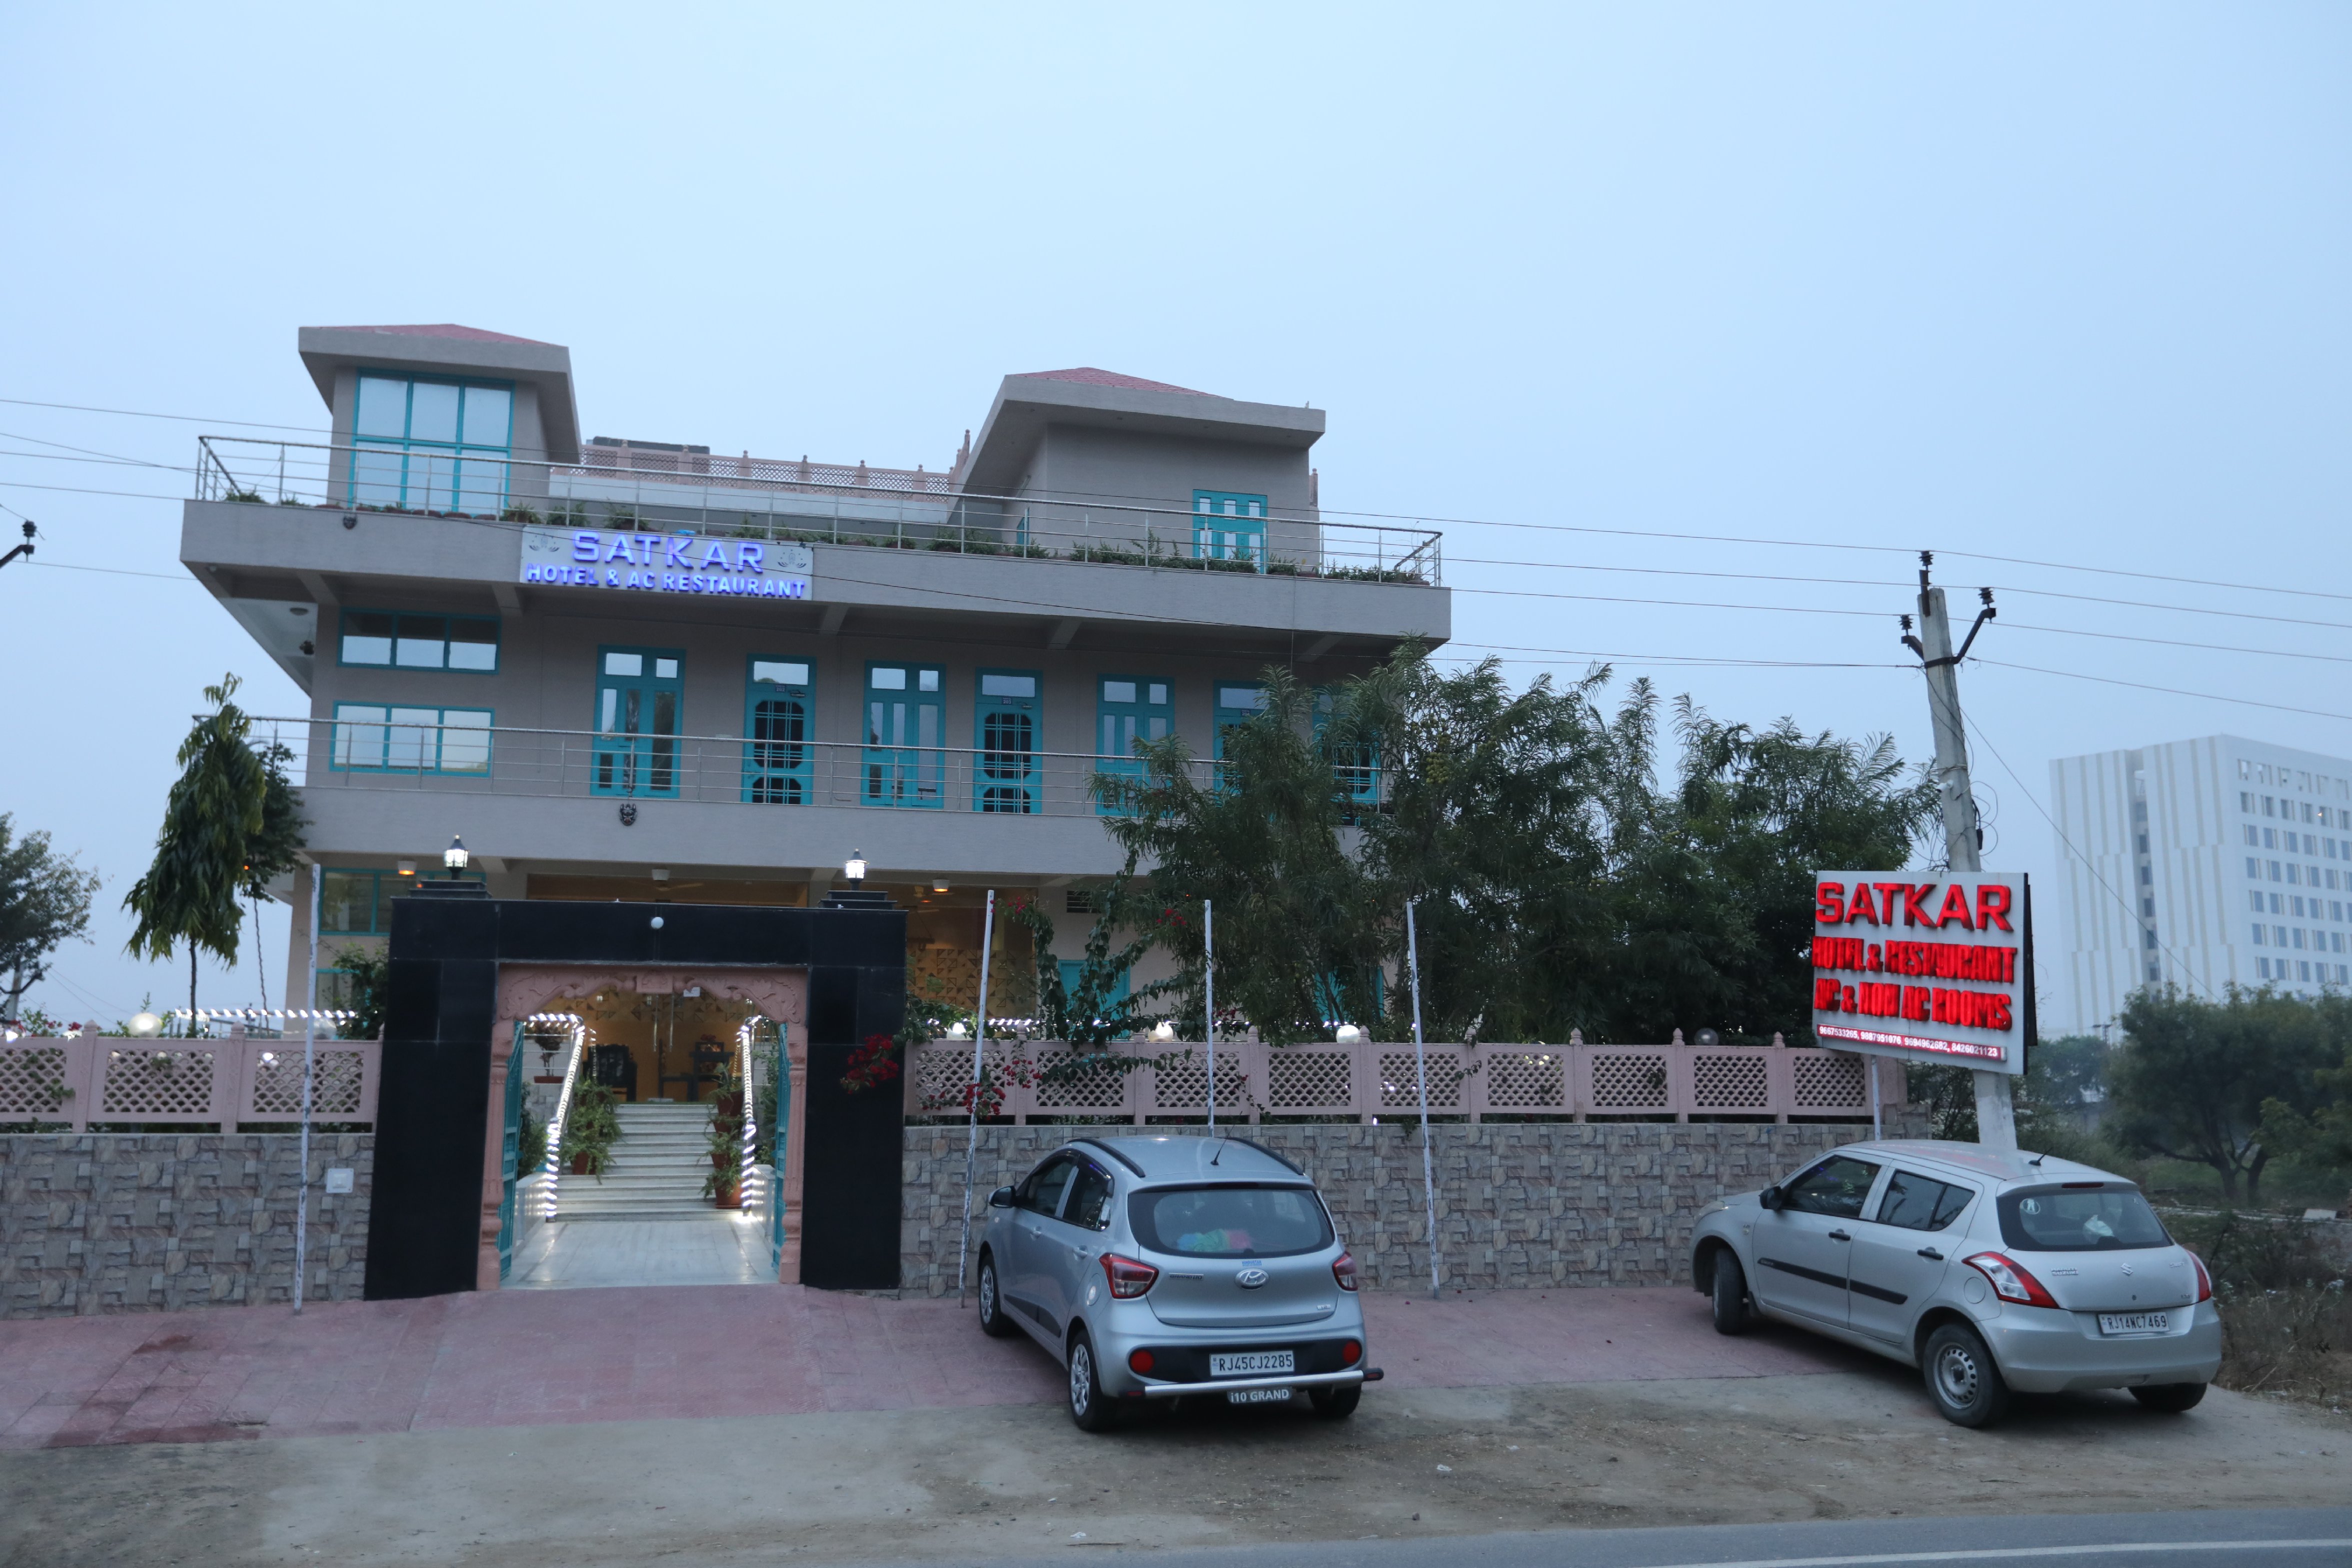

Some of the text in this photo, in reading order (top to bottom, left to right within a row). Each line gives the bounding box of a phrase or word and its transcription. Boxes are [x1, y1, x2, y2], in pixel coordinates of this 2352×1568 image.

[573, 530, 764, 573] SATKAR
[527, 564, 805, 598] HOTEL & AC RESTAURANT
[1815, 882, 2013, 932] SATKAR
[1812, 936, 2017, 984] HOTEL & RESTAURANT
[1841, 986, 1857, 1014] &
[1858, 982, 1900, 1017] NON
[1932, 987, 2012, 1030] ROOMS
[1219, 1354, 1292, 1371] RJ45CJ2285
[1230, 1389, 1289, 1403] i10 GRAND
